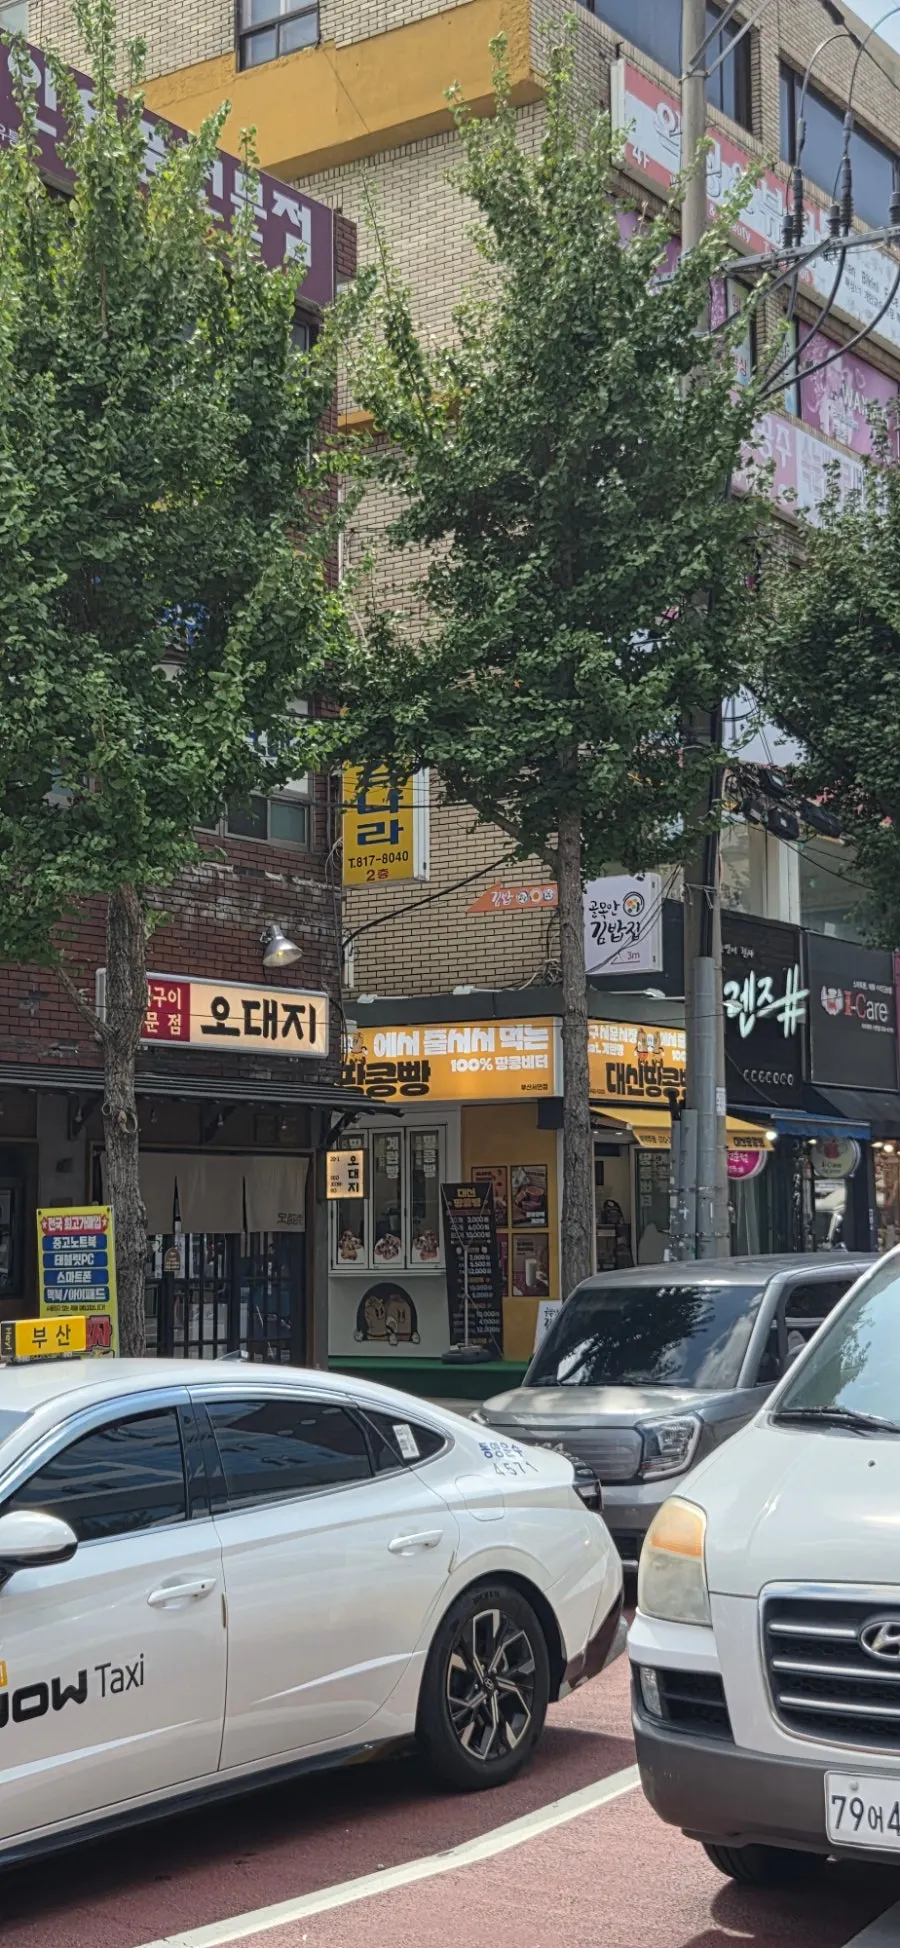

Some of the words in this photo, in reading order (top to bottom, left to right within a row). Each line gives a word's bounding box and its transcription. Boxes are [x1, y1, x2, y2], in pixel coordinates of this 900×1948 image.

[632, 147, 651, 169] 4F
[347, 850, 409, 869] T.817-8040
[366, 868, 389, 882] 2층
[491, 890, 513, 907] 김밥
[588, 900, 621, 919] 골목안
[590, 919, 641, 946] 김밥집
[627, 951, 640, 960] 3m
[148, 984, 182, 1010] 구이
[843, 990, 888, 1022] I-Care
[200, 995, 317, 1045] 오대지
[373, 1030, 420, 1058] 에서
[423, 1027, 495, 1056] 줄서서
[499, 1024, 549, 1051] 먹는
[450, 1057, 493, 1073] 100%
[347, 1155, 360, 1193] 오대지
[48, 1216, 63, 1231] 전국
[52, 1236, 97, 1249] 중고노트북
[56, 1270, 92, 1284] 스마트폰
[32, 1324, 71, 1348] 부산
[493, 1460, 540, 1477] 4571
[94, 1653, 144, 1698] Taxi
